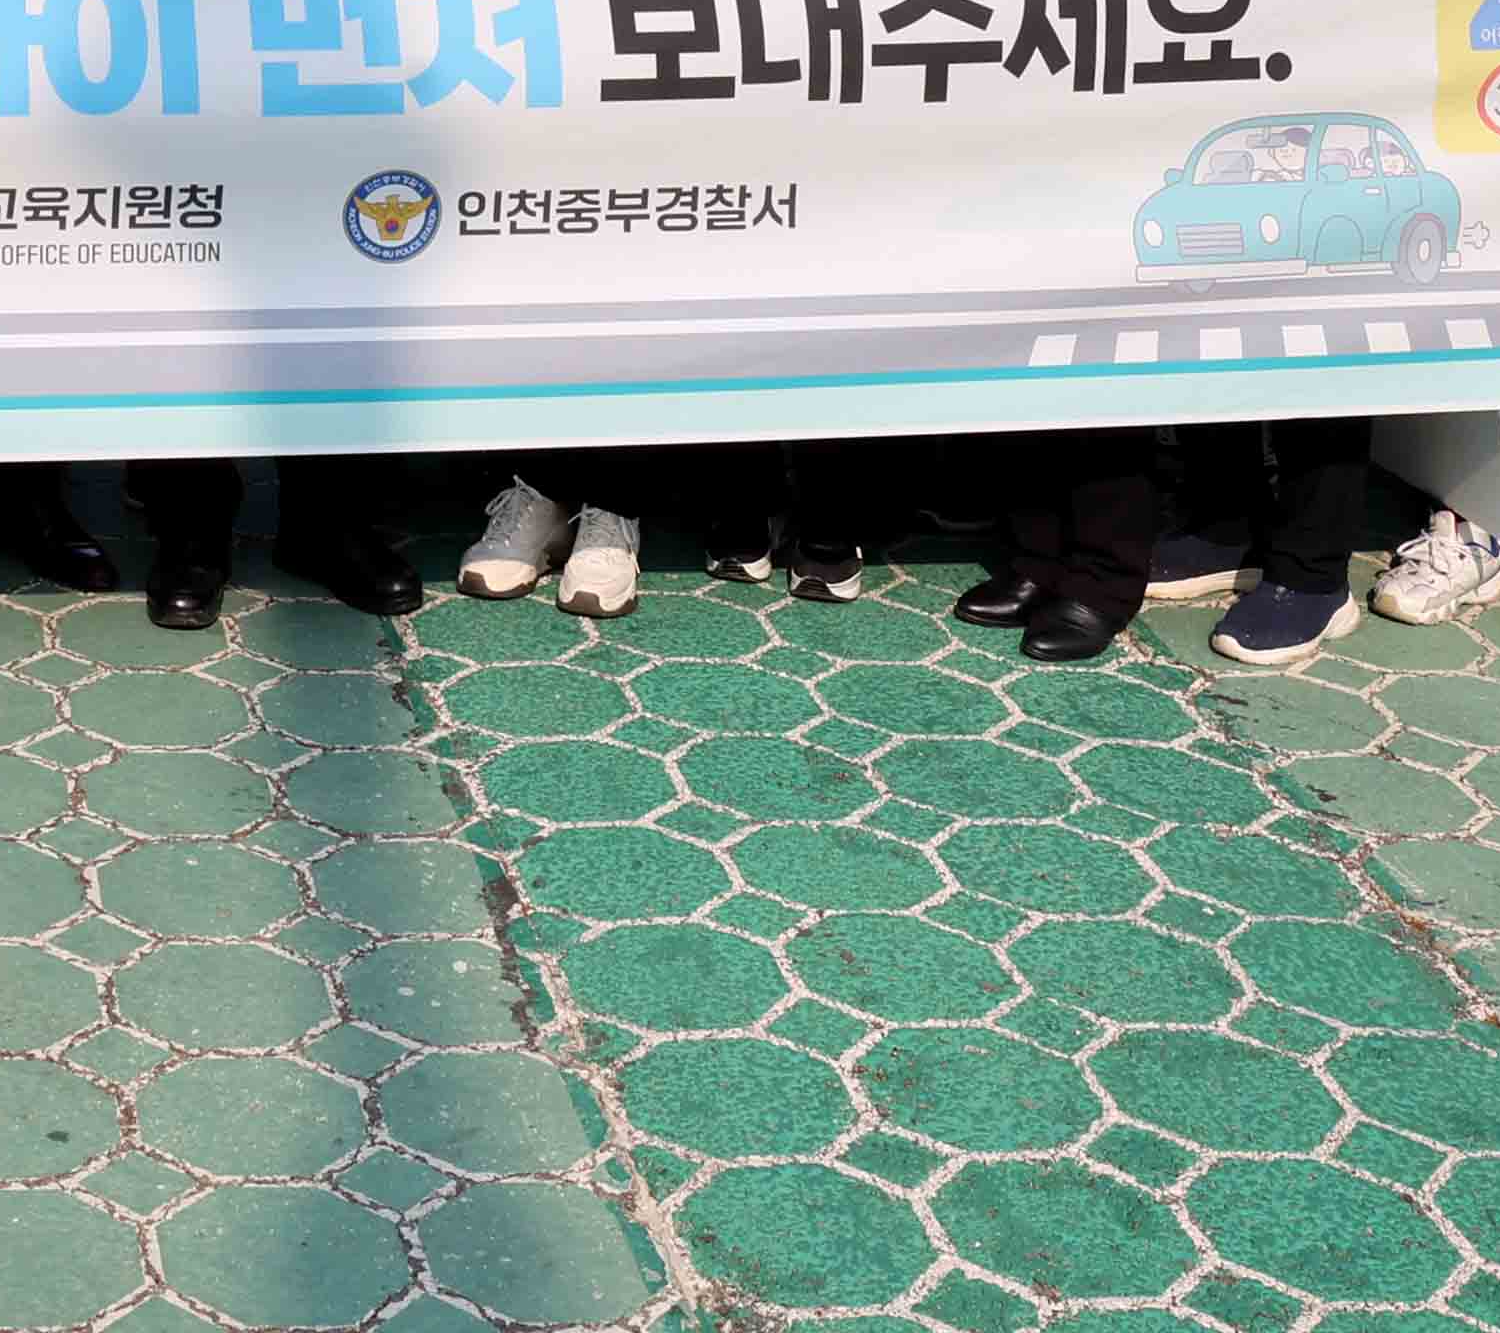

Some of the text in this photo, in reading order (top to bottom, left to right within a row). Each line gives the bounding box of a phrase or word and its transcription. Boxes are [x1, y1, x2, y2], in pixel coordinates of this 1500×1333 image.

[456, 182, 800, 239] 인천중부경찰서
[0, 243, 69, 268] OFFICE
[74, 243, 101, 266] OF
[108, 240, 222, 266] EDUCATION
